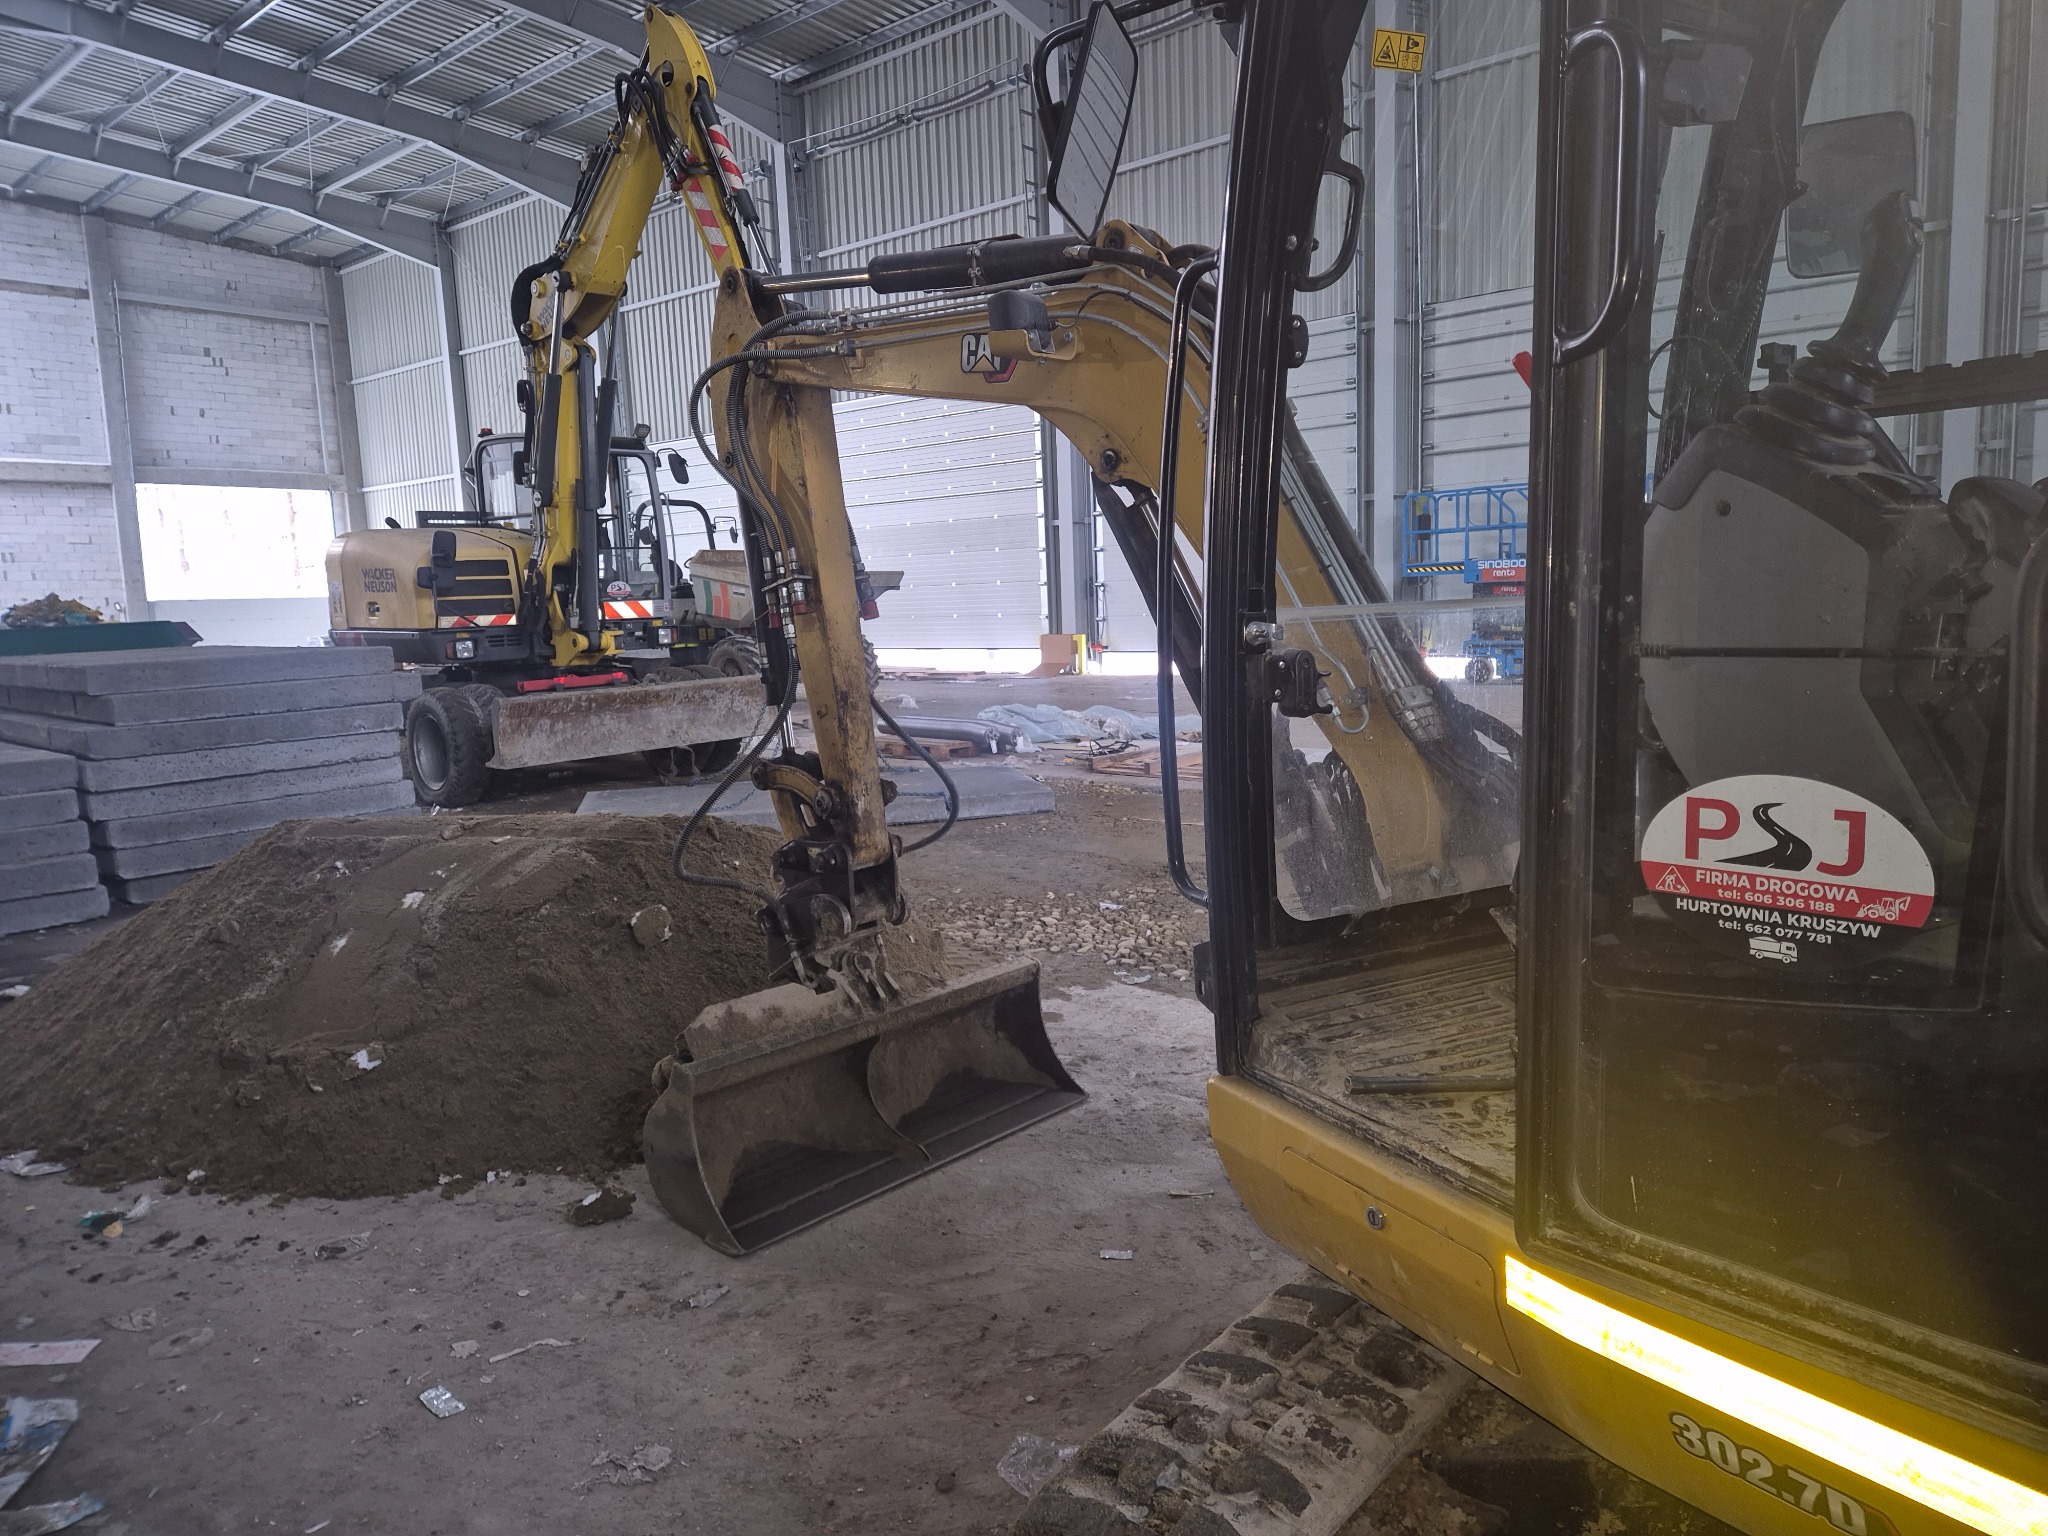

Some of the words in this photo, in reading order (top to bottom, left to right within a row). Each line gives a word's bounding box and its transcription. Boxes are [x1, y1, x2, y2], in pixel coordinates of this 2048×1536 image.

[361, 568, 396, 580] WACKER
[1477, 559, 1526, 570] SINOBOO
[1493, 569, 1515, 577] renta
[364, 580, 398, 592] NEUSON
[1695, 869, 1751, 889] FIRMA
[1755, 877, 1860, 904] DROGOWA
[1717, 888, 1741, 900] tel:
[1744, 892, 1773, 904] 606
[1776, 895, 1805, 909] 306
[1808, 900, 1835, 913] 188
[1676, 897, 1783, 925] HURTOWNIA
[1787, 913, 1881, 939] KRUSZYW
[1718, 919, 1742, 930] tel:
[1744, 923, 1772, 935] 662
[1775, 928, 1803, 940] 077
[1806, 932, 1832, 945] 781
[1670, 1413, 1868, 1536] 302.7D
